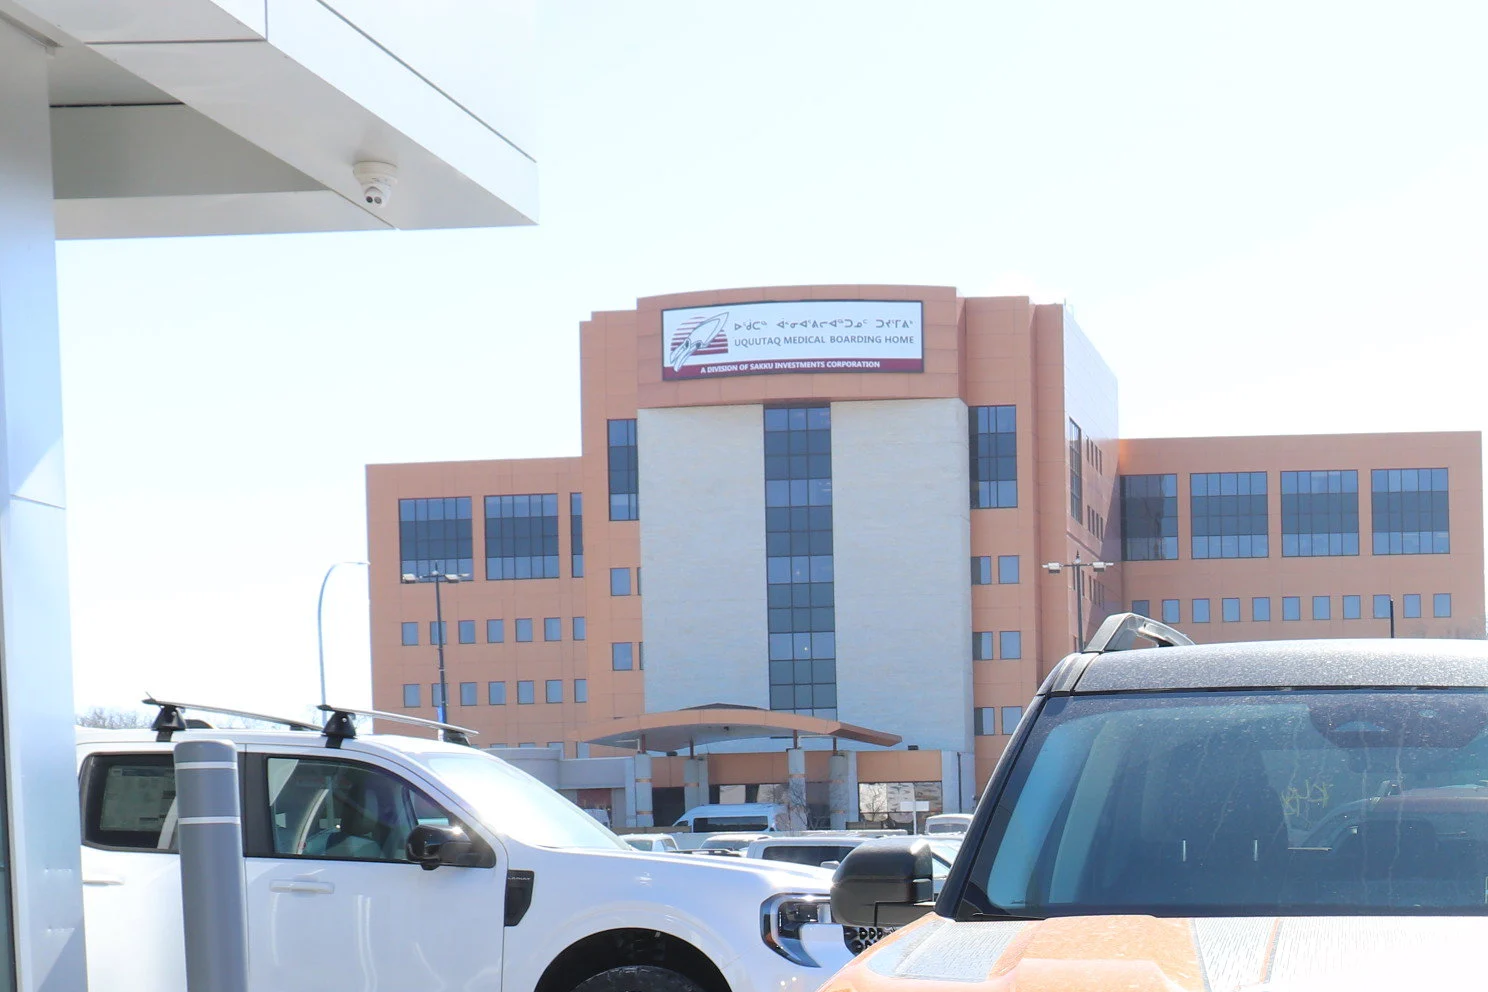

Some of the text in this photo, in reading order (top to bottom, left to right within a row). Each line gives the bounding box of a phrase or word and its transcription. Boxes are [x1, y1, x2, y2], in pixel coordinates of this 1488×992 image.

[734, 335, 914, 348] UQUUTAQ MEDICAL BOARDING HOME
[707, 365, 738, 373] DIVISION
[749, 362, 774, 370] SAKKU
[775, 361, 825, 369] INVESTMENTS
